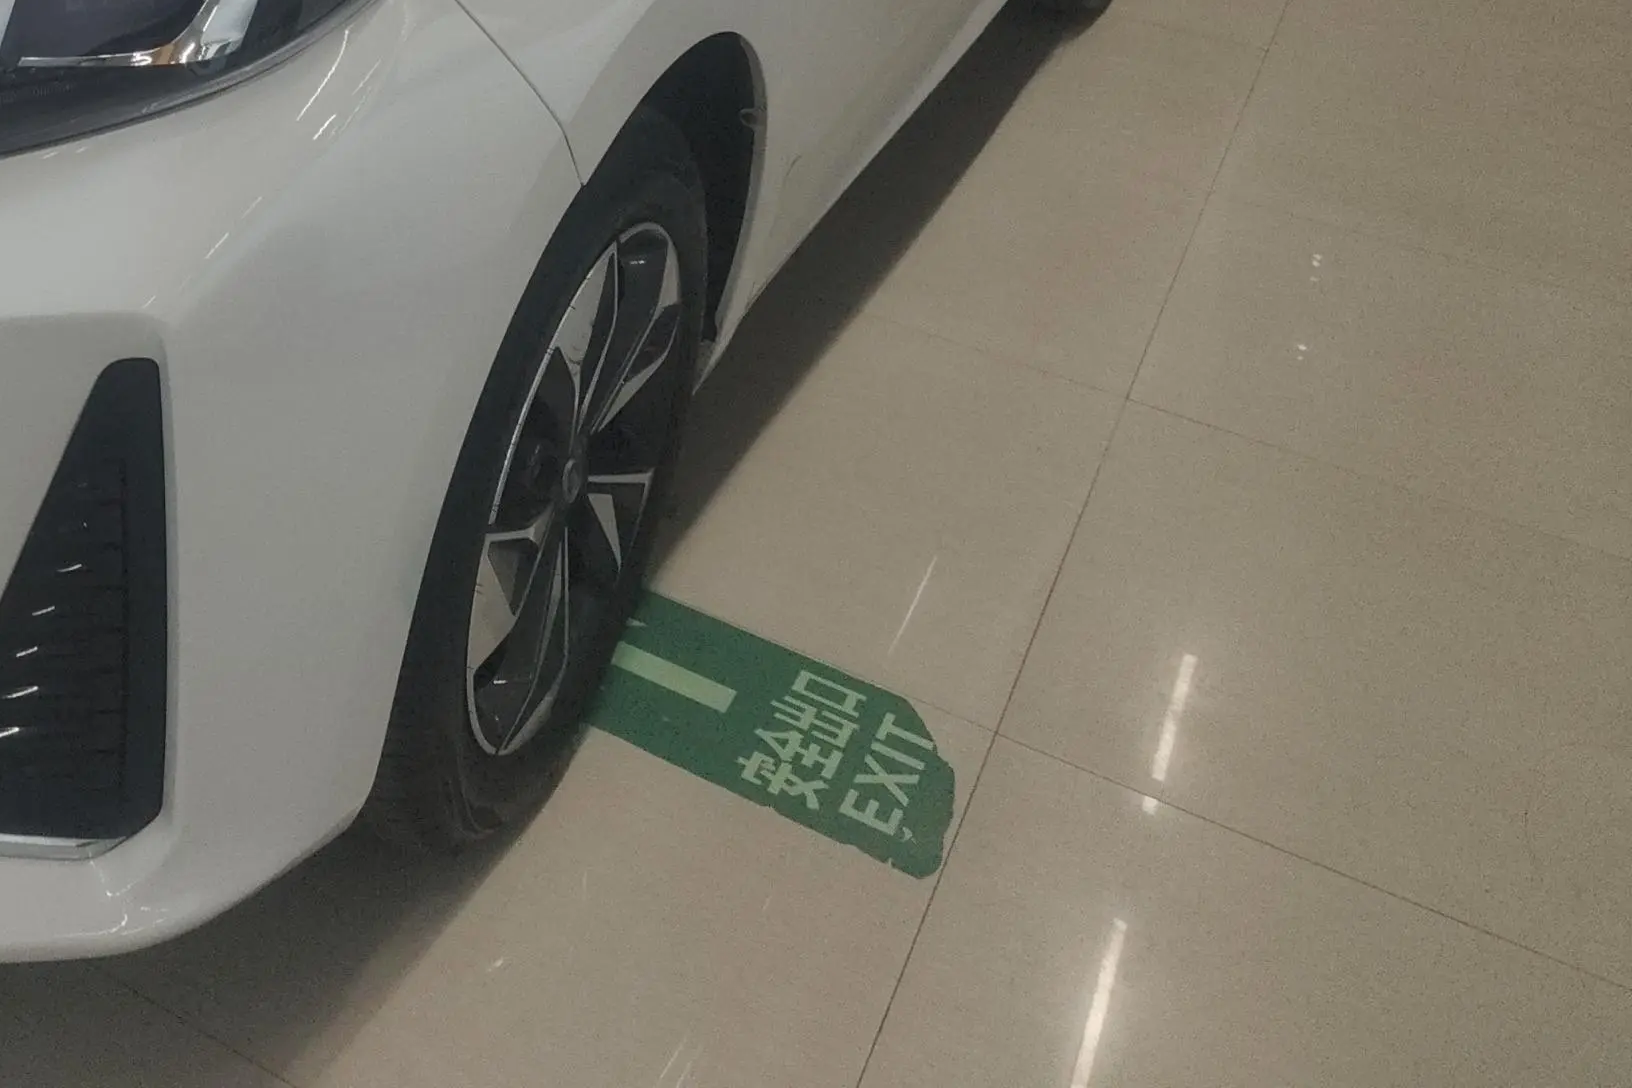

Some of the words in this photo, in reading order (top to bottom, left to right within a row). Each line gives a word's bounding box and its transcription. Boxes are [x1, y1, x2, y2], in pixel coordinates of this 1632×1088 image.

[735, 669, 867, 810] 安全出口
[839, 713, 934, 836] EXIT
